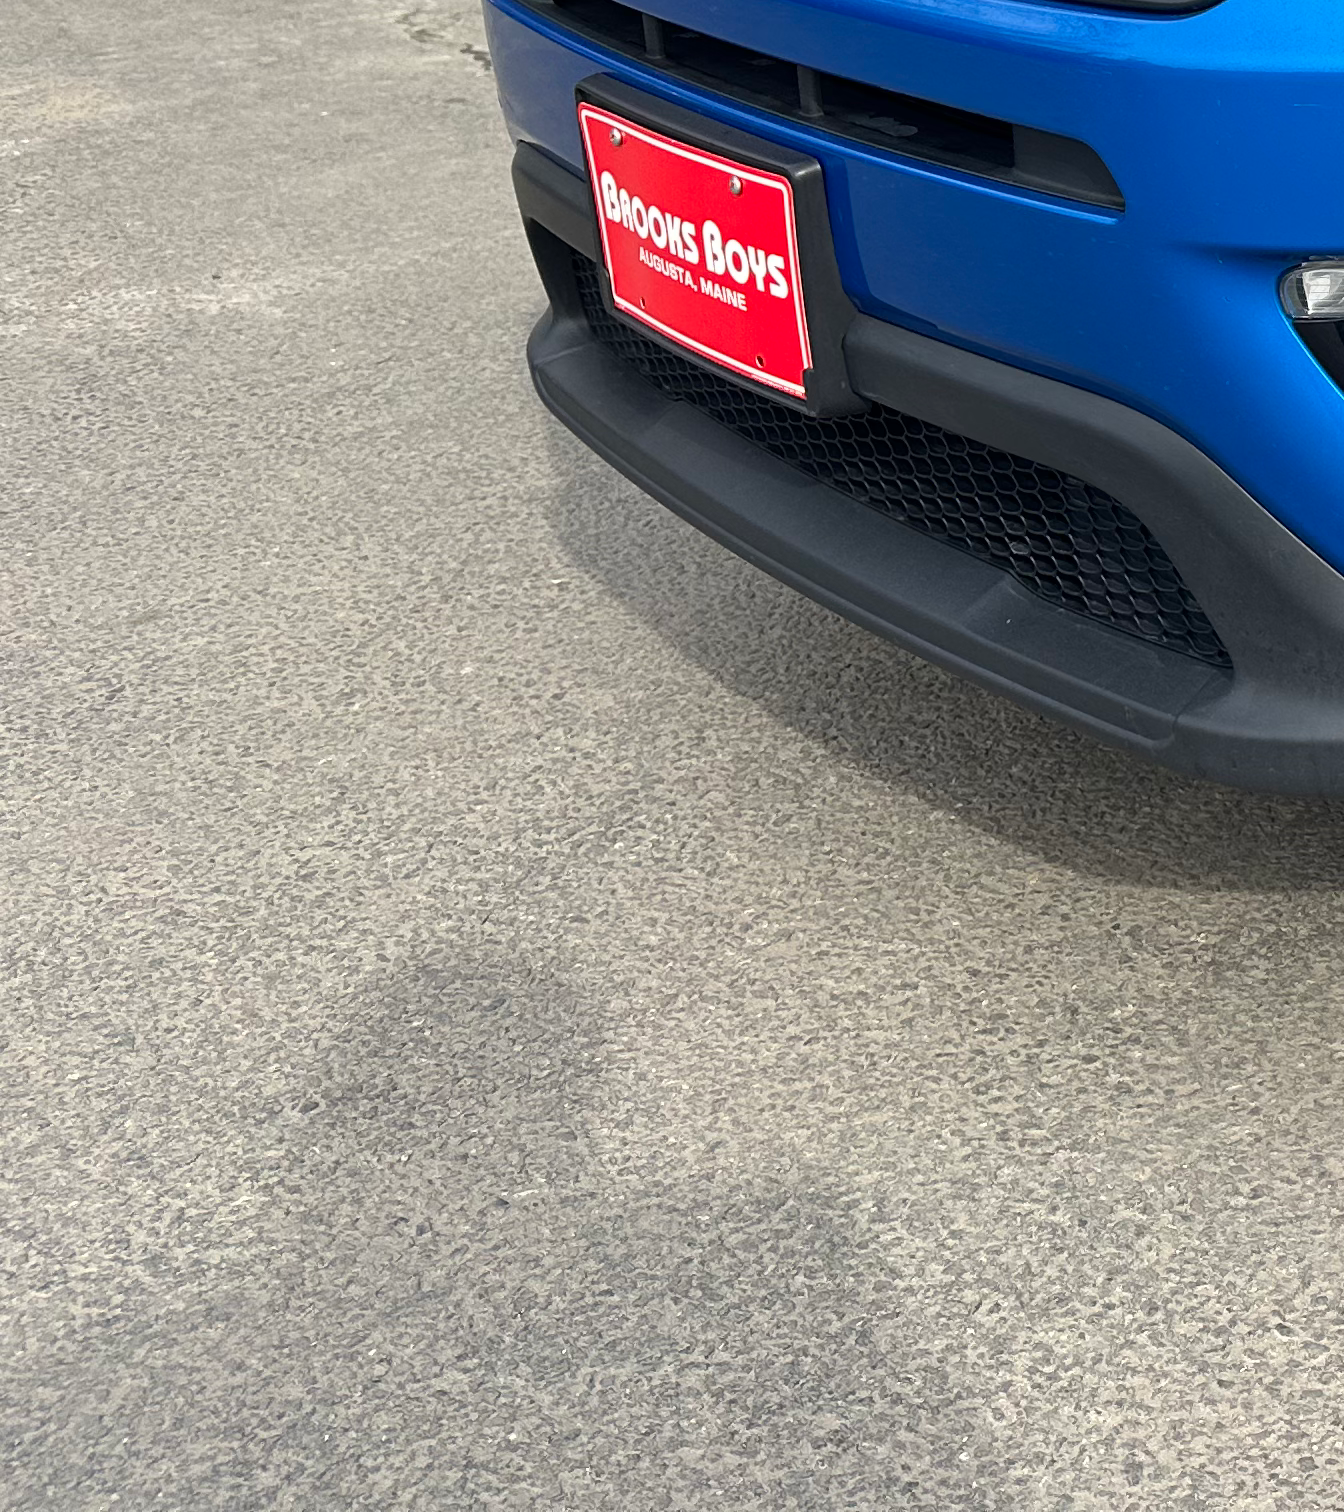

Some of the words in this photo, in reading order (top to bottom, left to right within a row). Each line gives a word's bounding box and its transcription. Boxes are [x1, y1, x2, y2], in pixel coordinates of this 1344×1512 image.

[600, 170, 699, 266] BROOKS
[702, 219, 789, 300] BOYS
[639, 245, 698, 293] AUGUSTA,
[699, 276, 748, 311] MAINE
